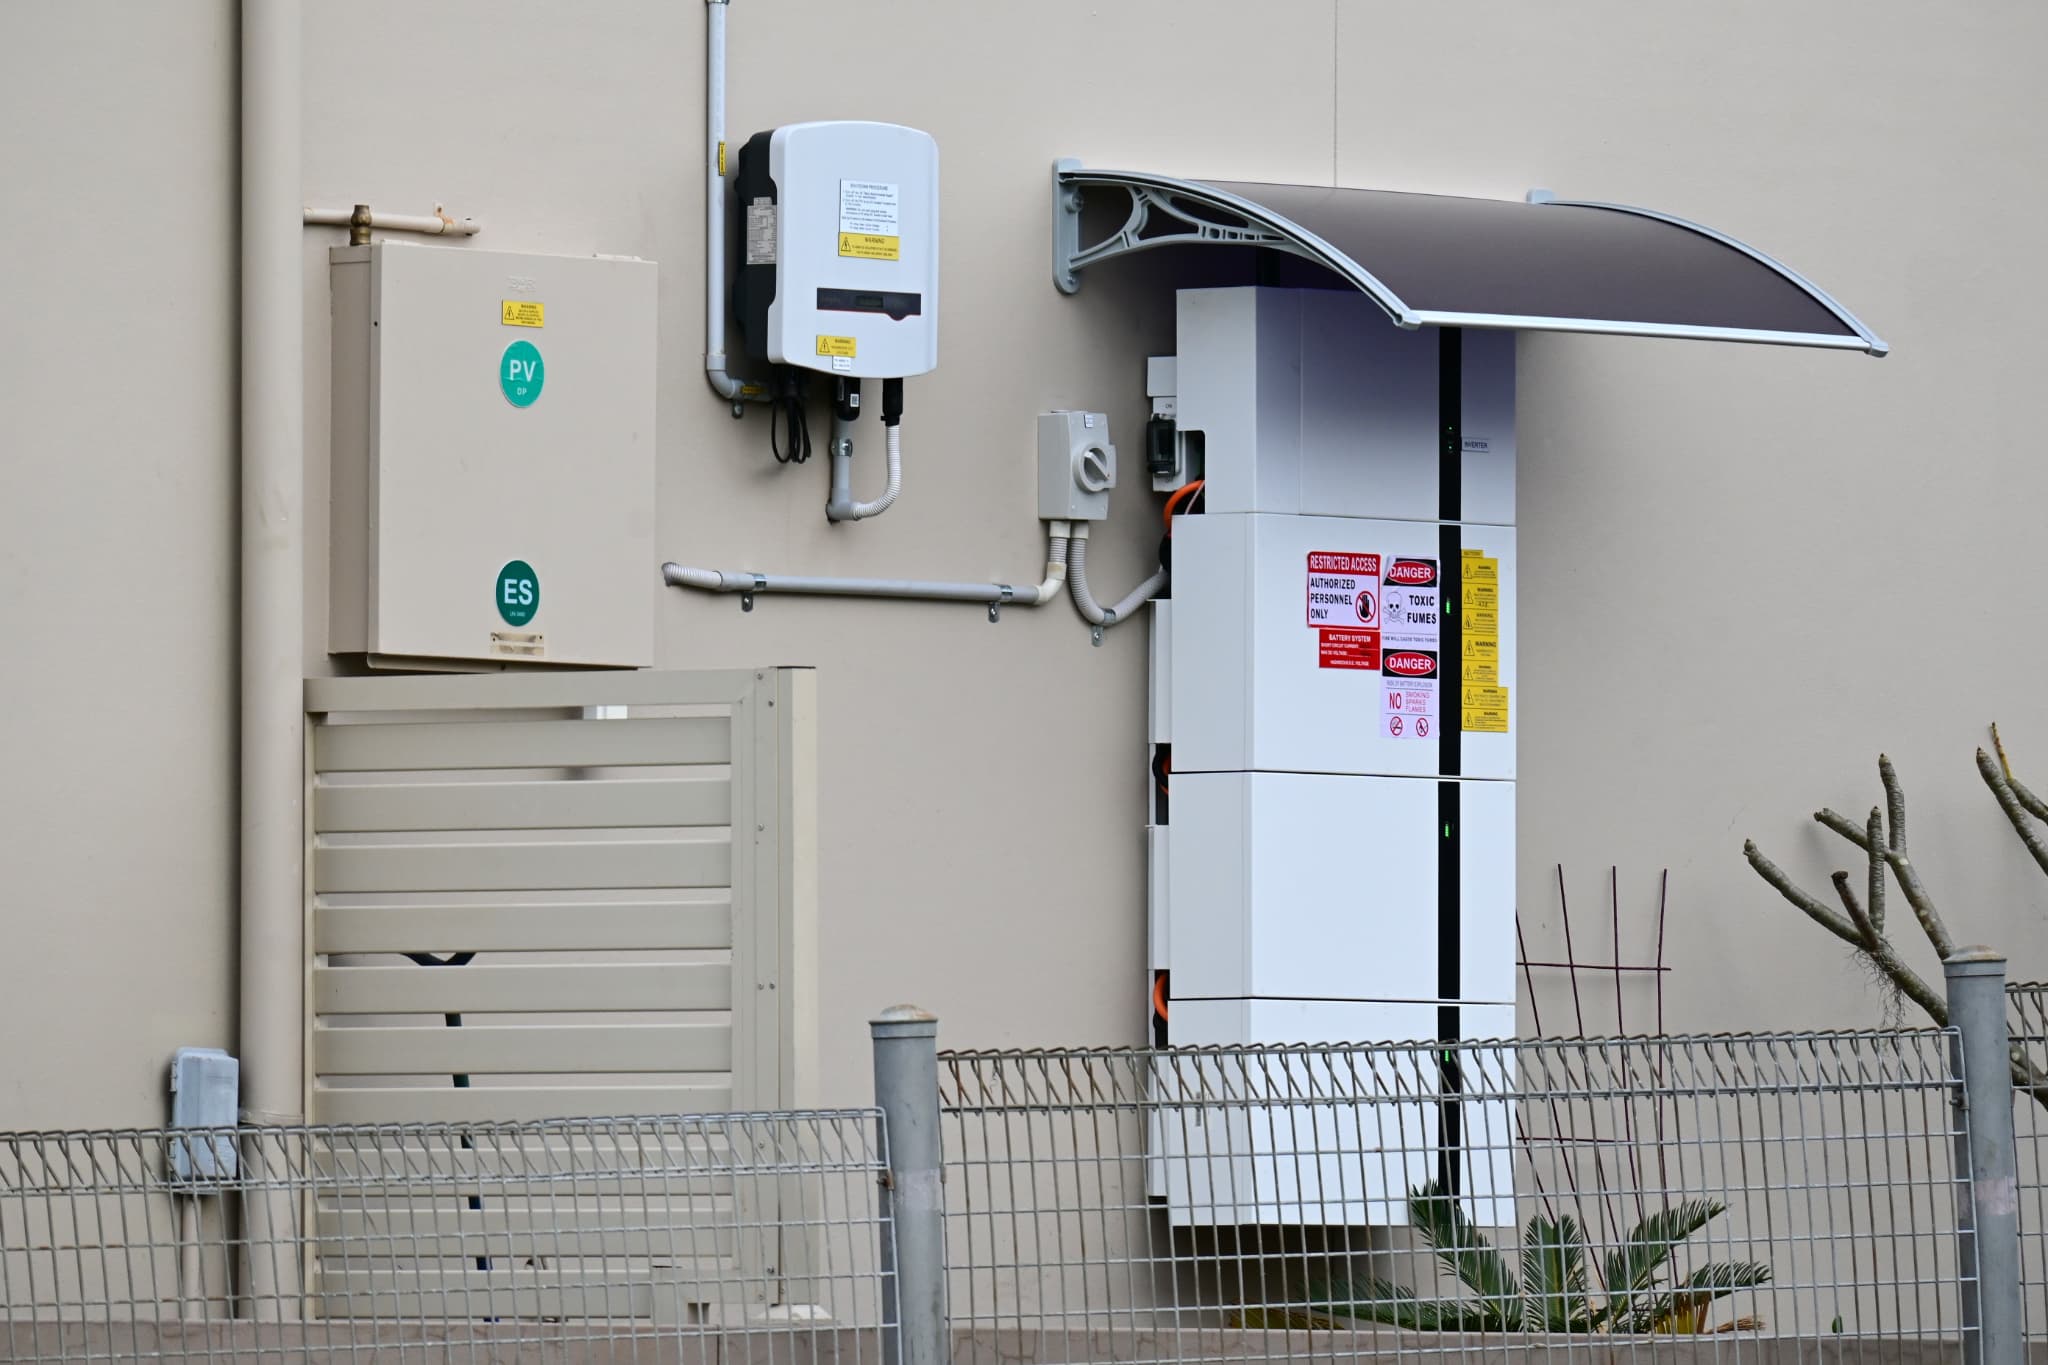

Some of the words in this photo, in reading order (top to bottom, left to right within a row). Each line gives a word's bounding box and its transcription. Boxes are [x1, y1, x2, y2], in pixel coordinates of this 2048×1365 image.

[510, 360, 536, 382] PV
[517, 387, 527, 395] DP
[1310, 555, 1349, 570] RESTRICTED
[1351, 557, 1377, 572] ACCESS
[1389, 566, 1431, 579] DANGER
[1310, 578, 1355, 589] AUTHORIZED
[504, 579, 532, 605] ES
[1310, 593, 1352, 605] PERSONNEL
[1409, 595, 1435, 606] TOXIC
[1310, 609, 1328, 619] ONLY
[1407, 613, 1437, 624] FUMES
[1389, 657, 1432, 670] DANGER
[1389, 692, 1402, 709] NO
[1405, 705, 1426, 713] FLAMES
